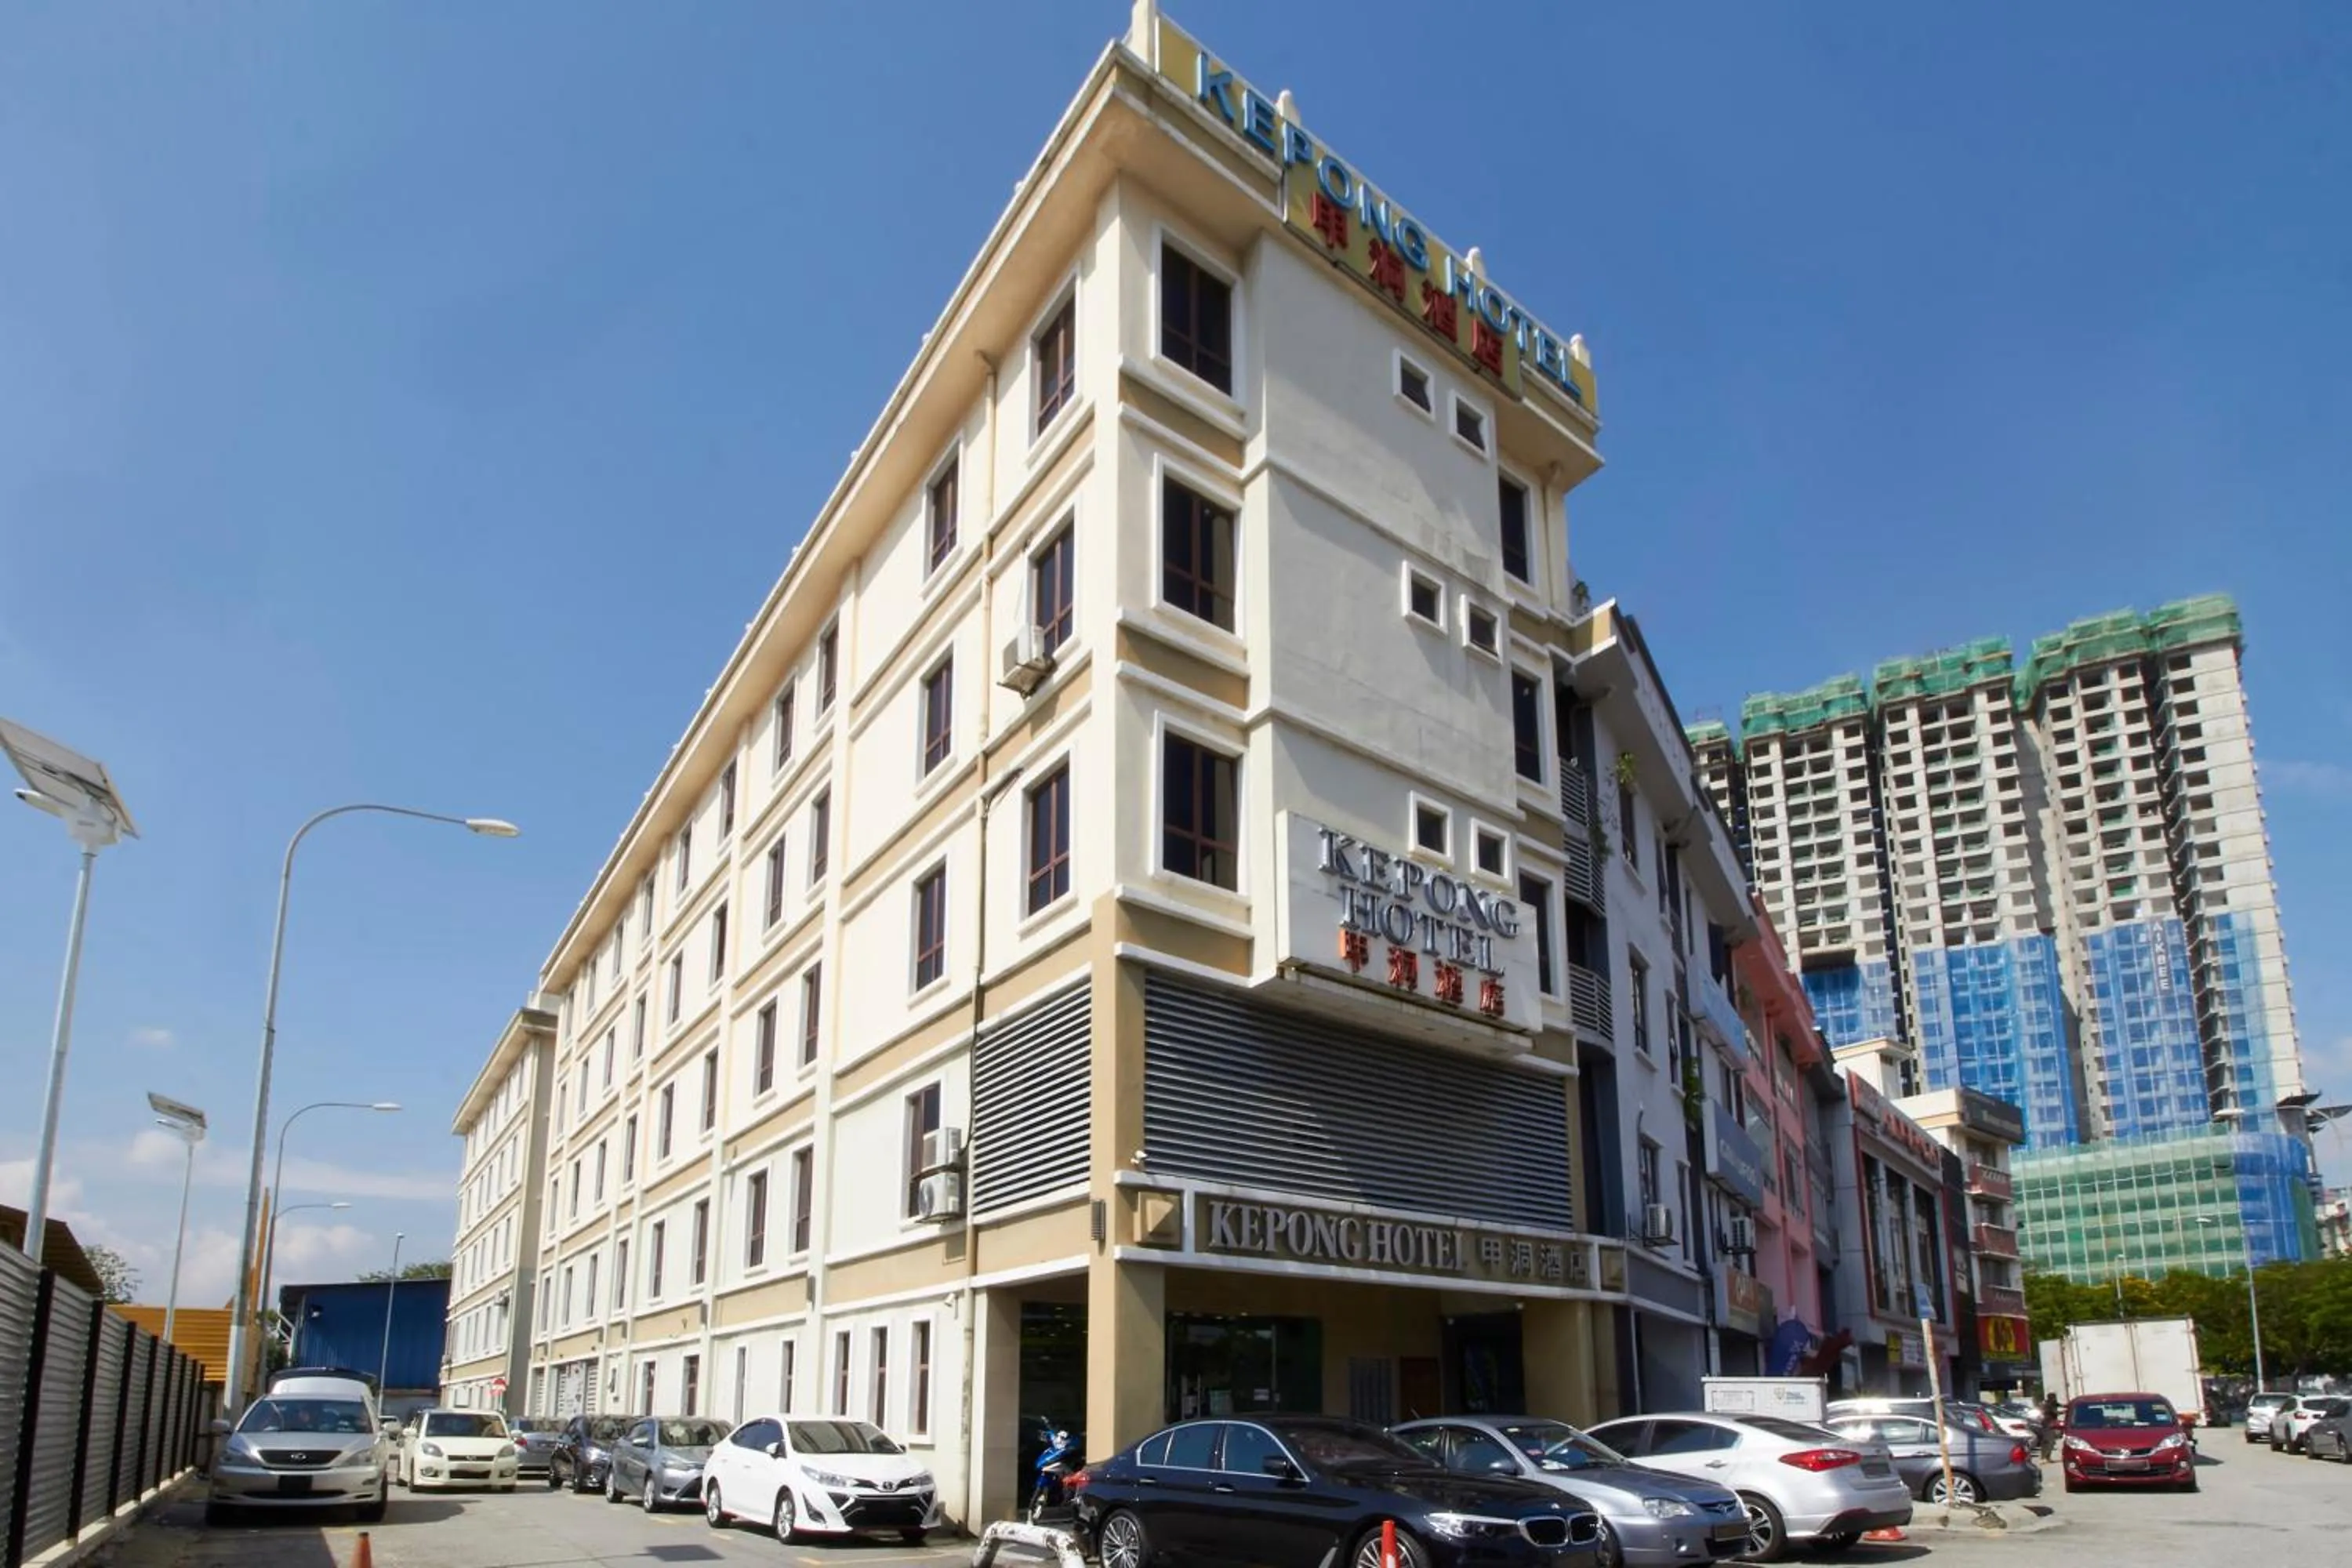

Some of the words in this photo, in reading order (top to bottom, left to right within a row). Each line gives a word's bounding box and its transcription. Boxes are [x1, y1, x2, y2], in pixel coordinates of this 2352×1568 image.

[1196, 51, 1431, 273] KEPONG
[1446, 254, 1583, 403] HOTEL
[1311, 190, 1504, 378] 甲洞酒店
[1317, 826, 1520, 939] KEPONG
[1339, 884, 1506, 978] HOTEL
[1208, 1200, 1361, 1261] KEPONG
[1367, 1219, 1468, 1272] HOTEL
[1481, 1237, 1588, 1284] 甲洞酒店
